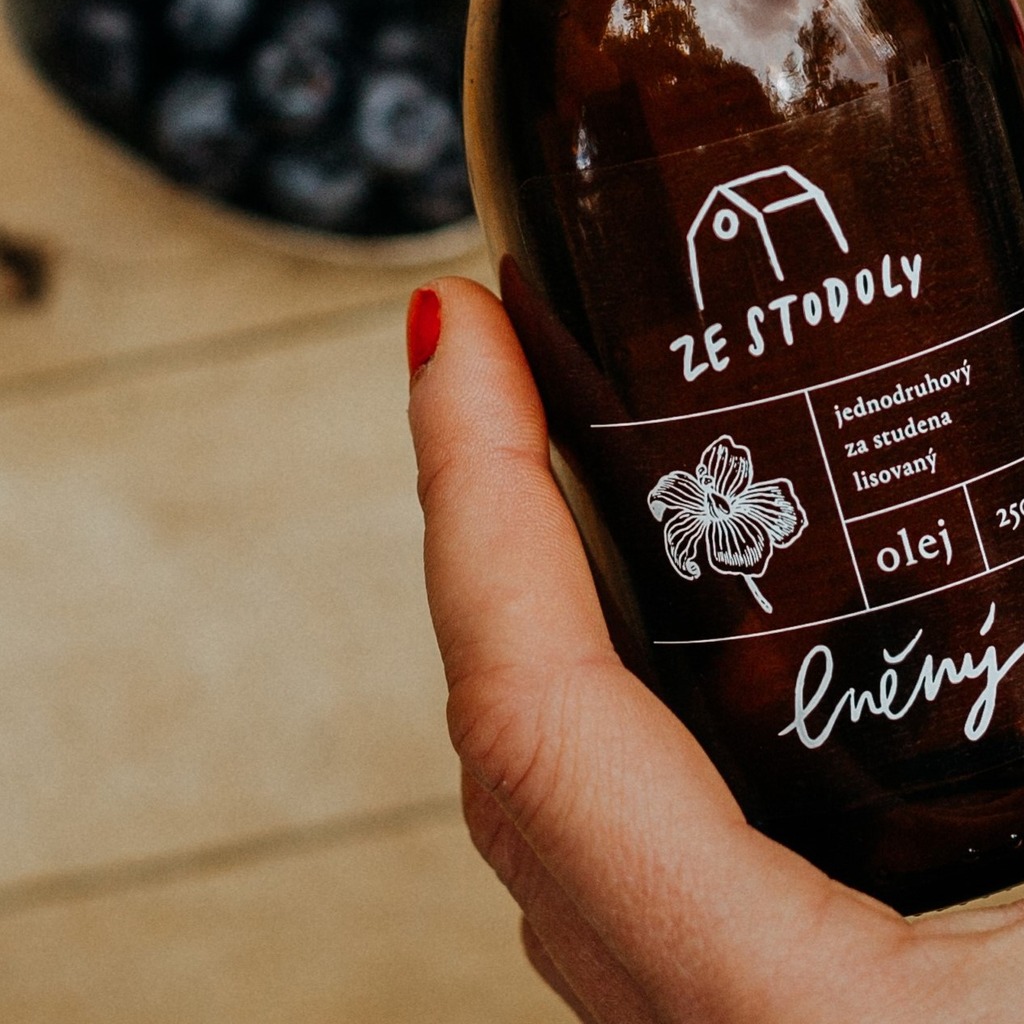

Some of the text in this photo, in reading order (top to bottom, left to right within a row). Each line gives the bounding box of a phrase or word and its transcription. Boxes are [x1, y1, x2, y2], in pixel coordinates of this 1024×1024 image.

[670, 254, 921, 381] ZE STODOLY
[834, 360, 971, 428] jednodruhový
[844, 411, 952, 458] za studena
[853, 448, 937, 491] lisovaný
[877, 519, 953, 572] olej
